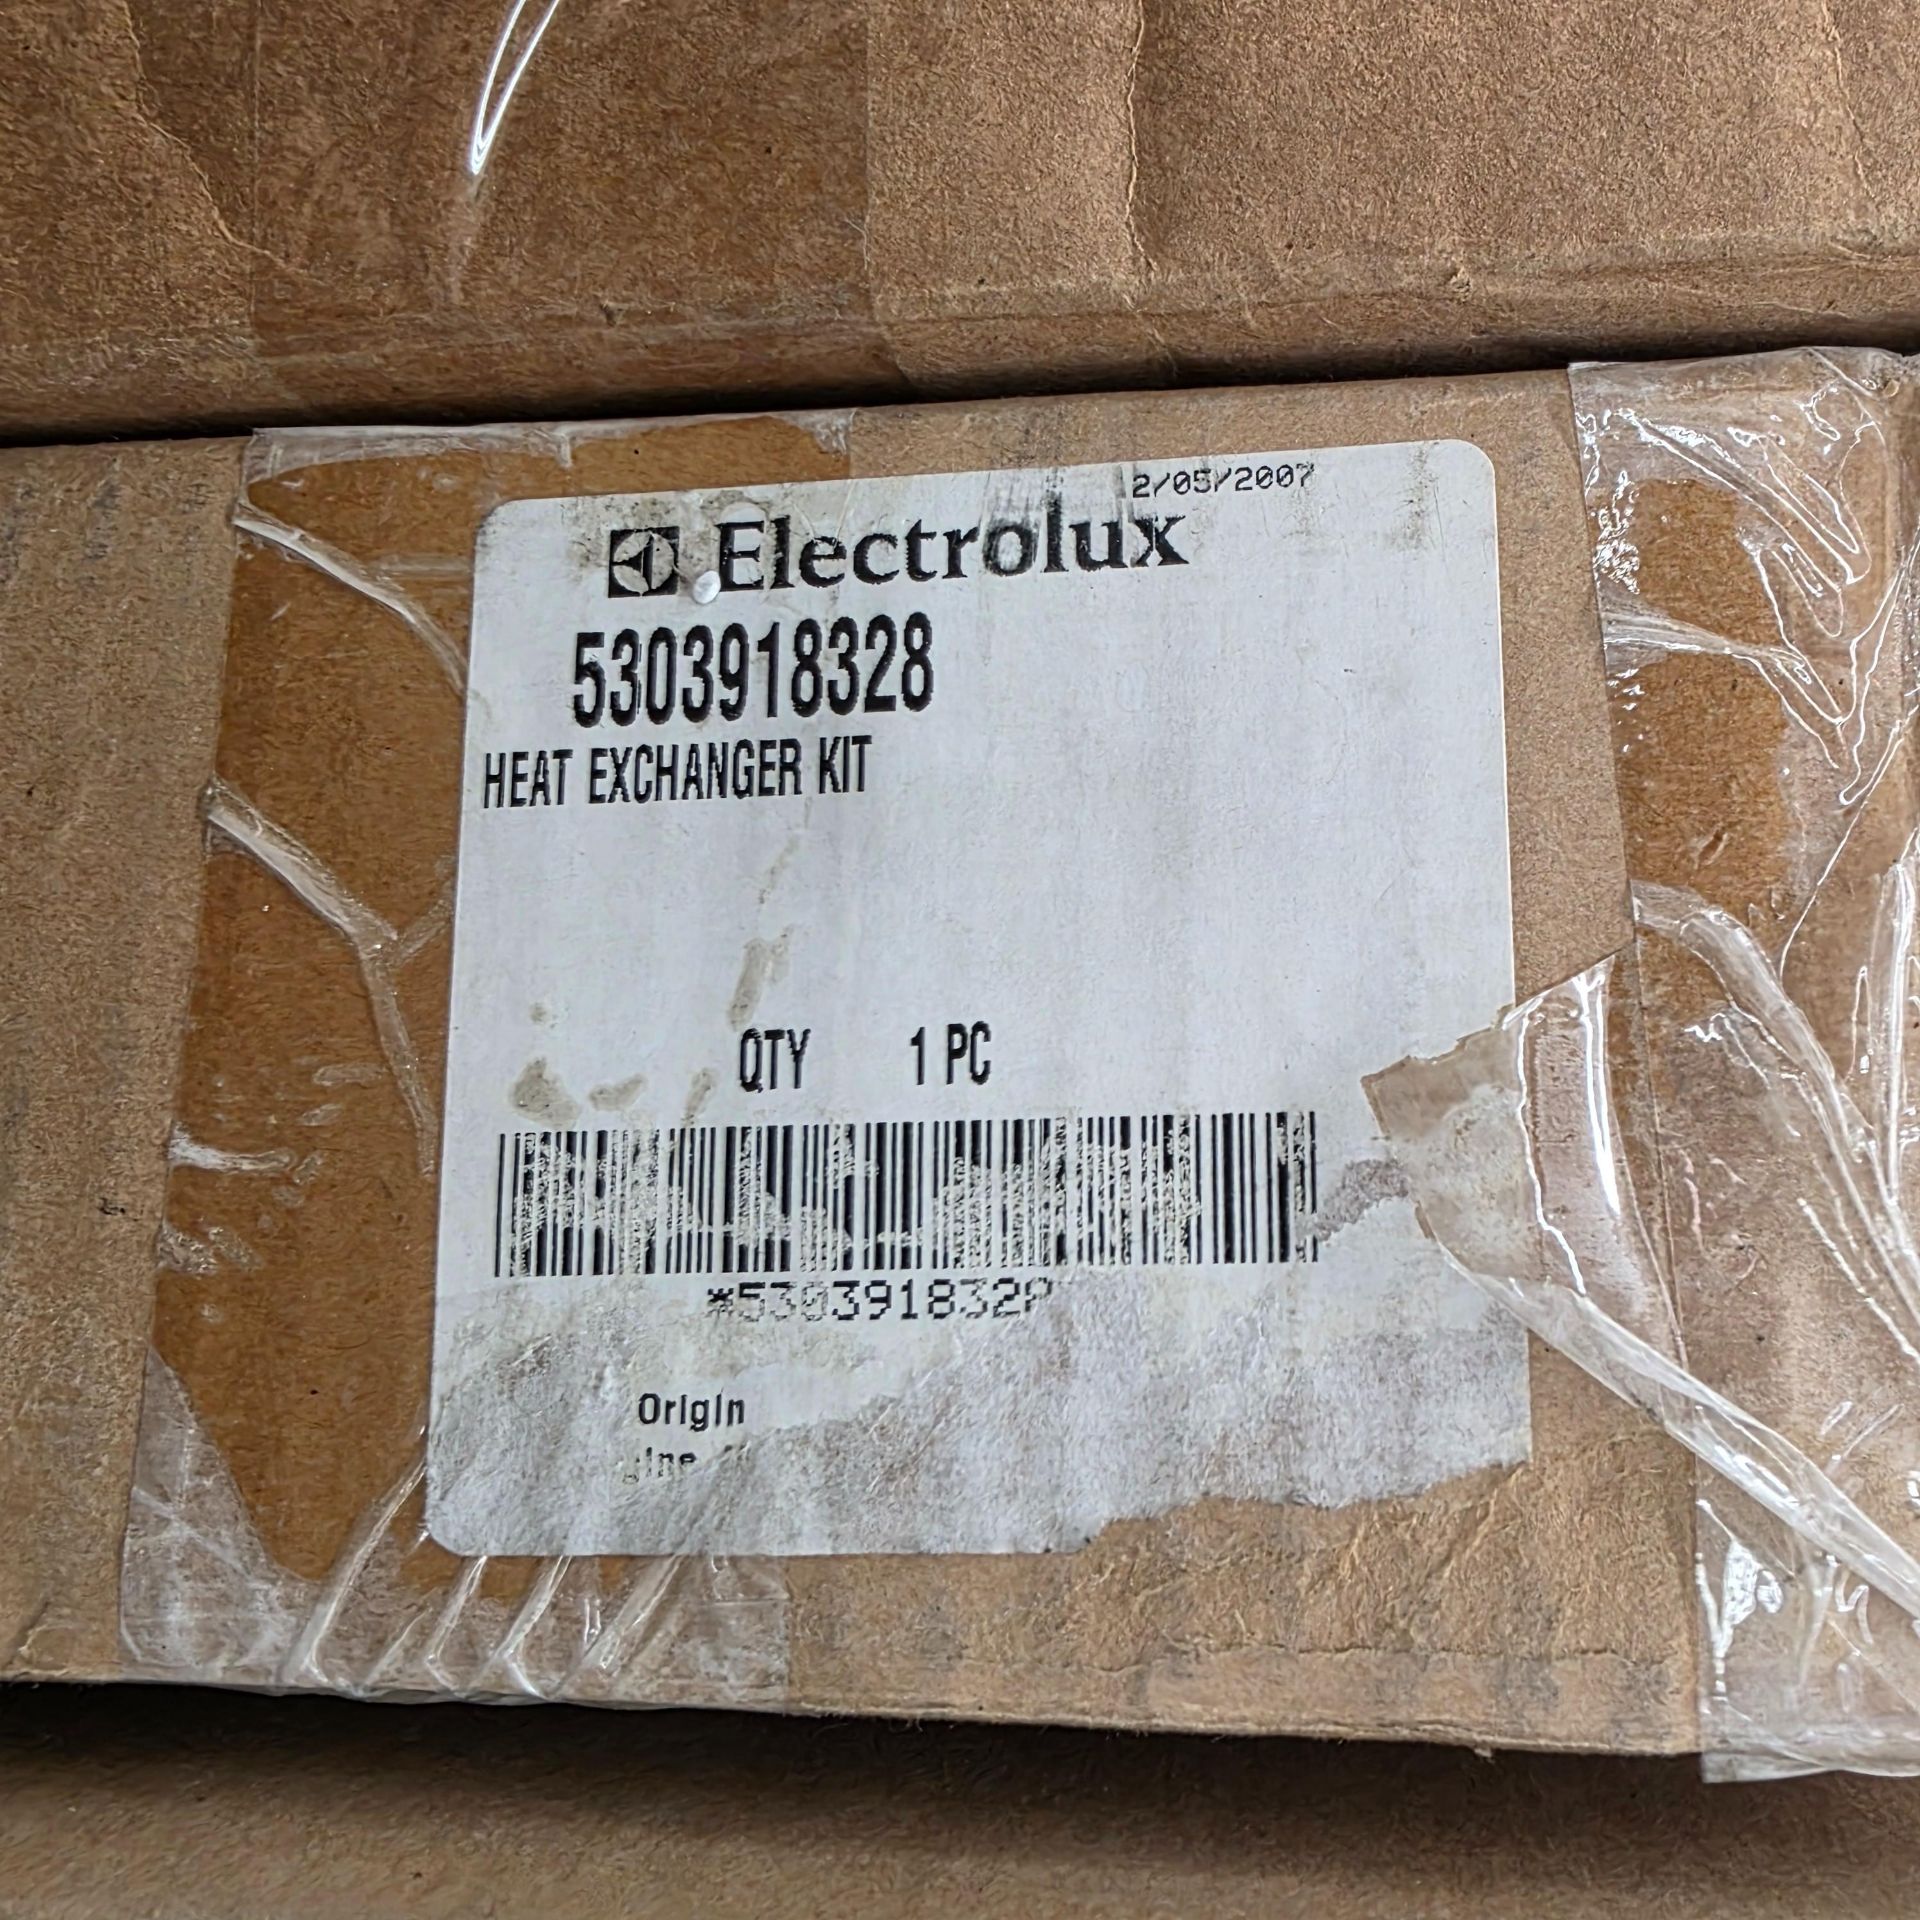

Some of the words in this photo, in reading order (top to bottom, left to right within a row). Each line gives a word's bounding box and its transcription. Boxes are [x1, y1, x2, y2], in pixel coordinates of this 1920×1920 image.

[719, 513, 1191, 594] Electrolux
[575, 610, 935, 729] 5303918328
[484, 748, 573, 809] HEAT
[588, 738, 802, 804] EXCHANGER
[818, 735, 872, 794] KIT
[740, 1027, 811, 1093] QTY
[910, 1026, 926, 1086] 1
[946, 1020, 992, 1085] PC
[638, 1392, 745, 1432] Origin
